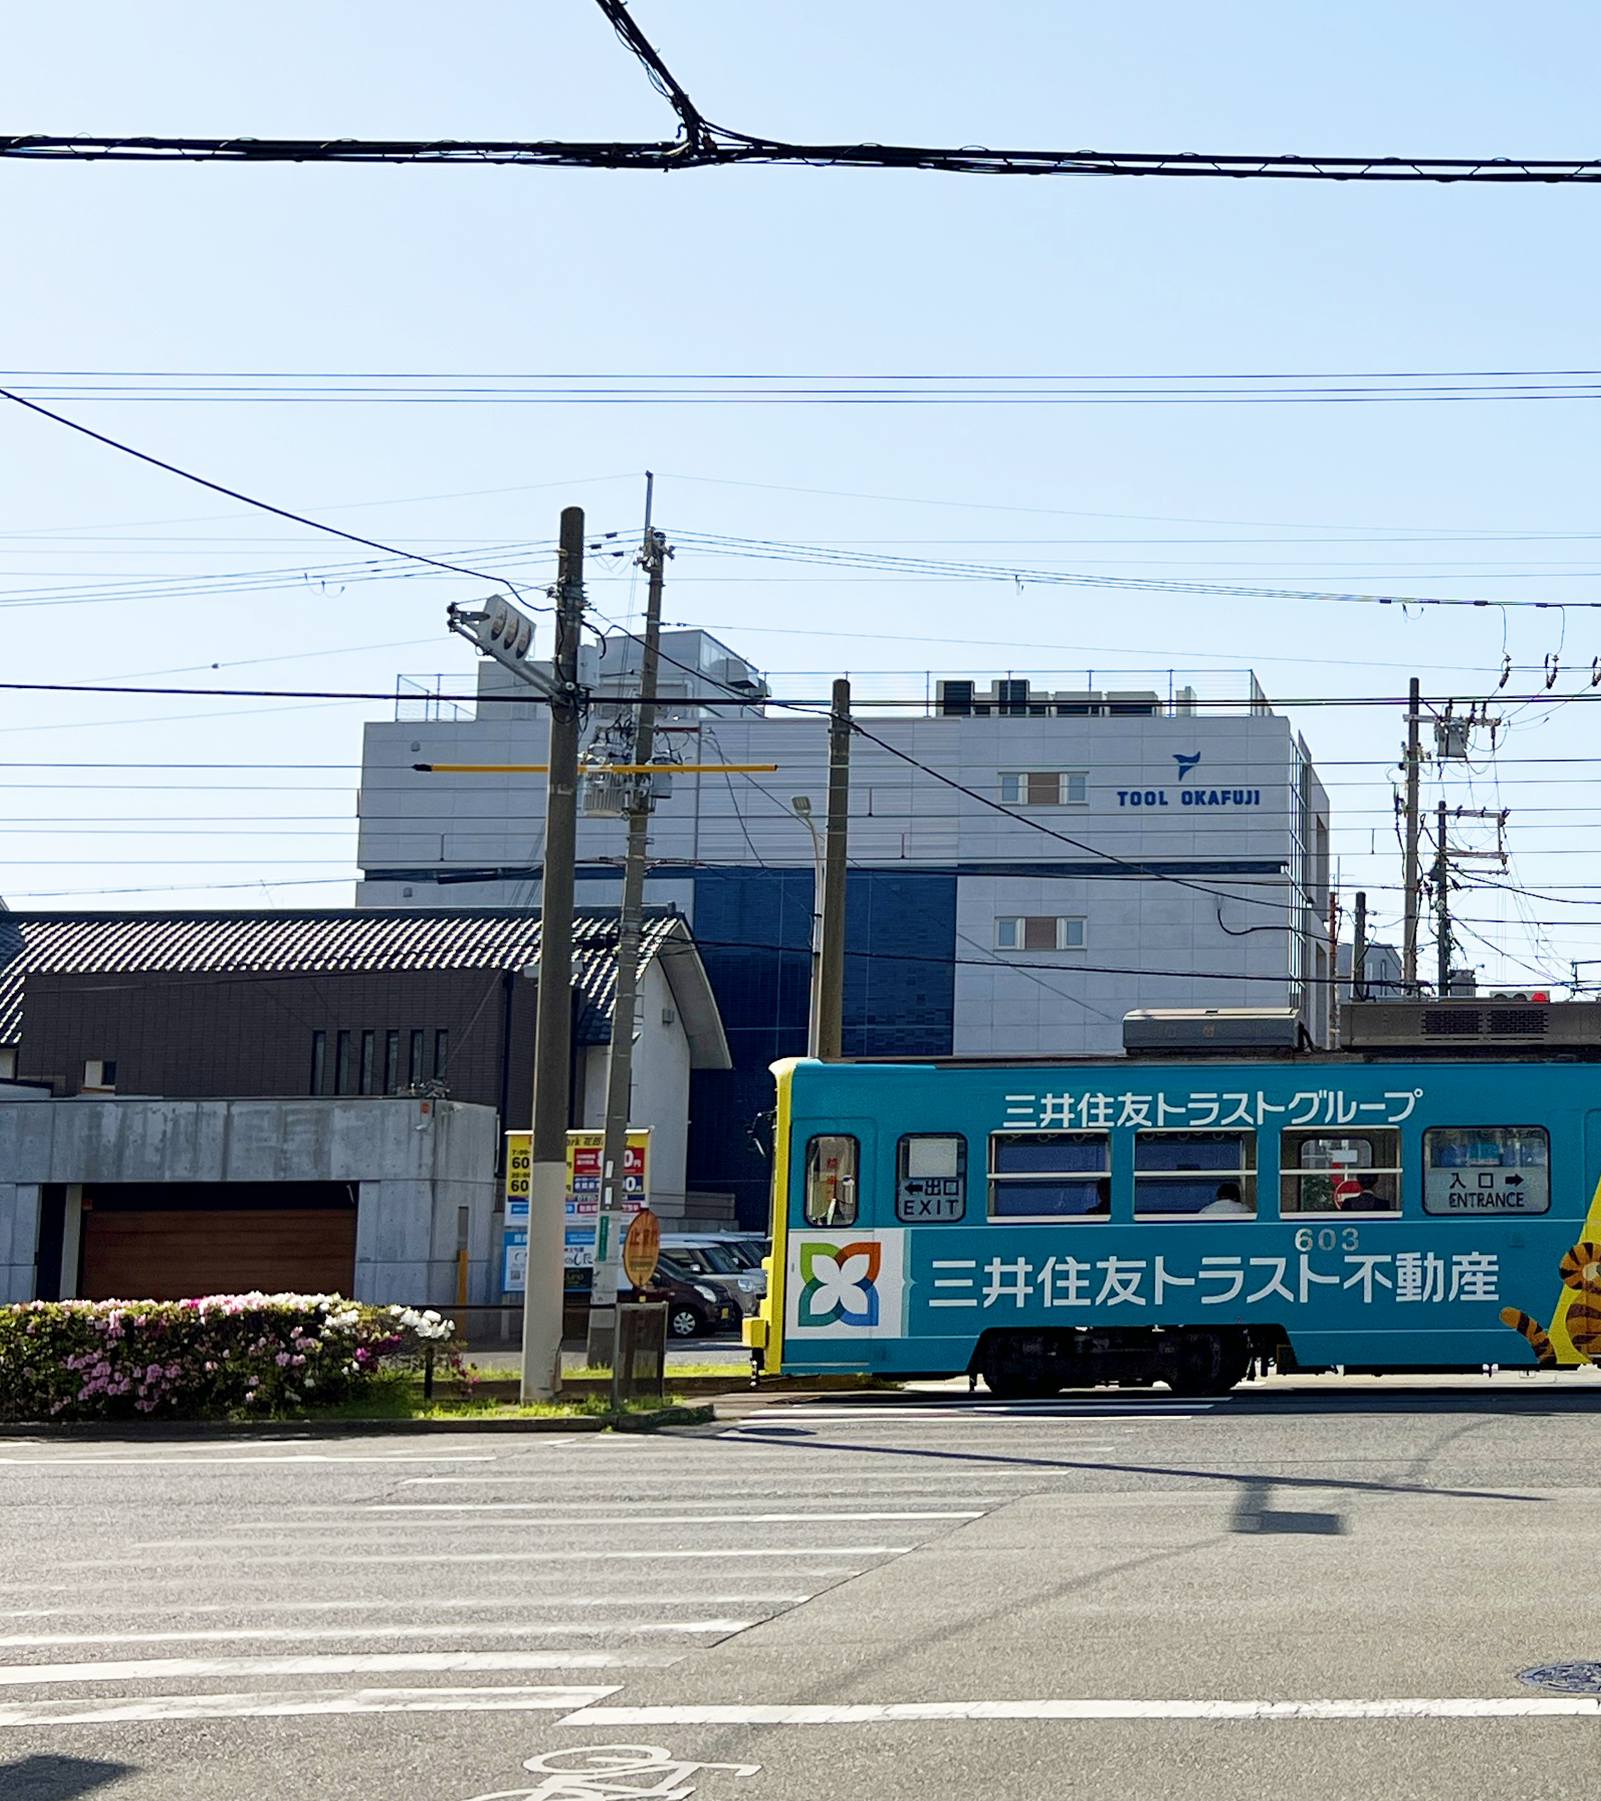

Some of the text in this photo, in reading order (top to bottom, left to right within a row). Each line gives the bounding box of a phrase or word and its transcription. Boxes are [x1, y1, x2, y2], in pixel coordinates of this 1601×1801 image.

[1117, 790, 1260, 806] TOOL OKAFUJI
[1003, 1088, 1424, 1128] 三井住友トラストグループ
[925, 1180, 960, 1195] 出口
[1449, 1172, 1494, 1189] 入口
[904, 1200, 960, 1215] EXIT
[1449, 1192, 1525, 1208] ENTRANCE
[1295, 1228, 1361, 1252] 603
[928, 1251, 1501, 1308] 三井住友トラスト不動産
